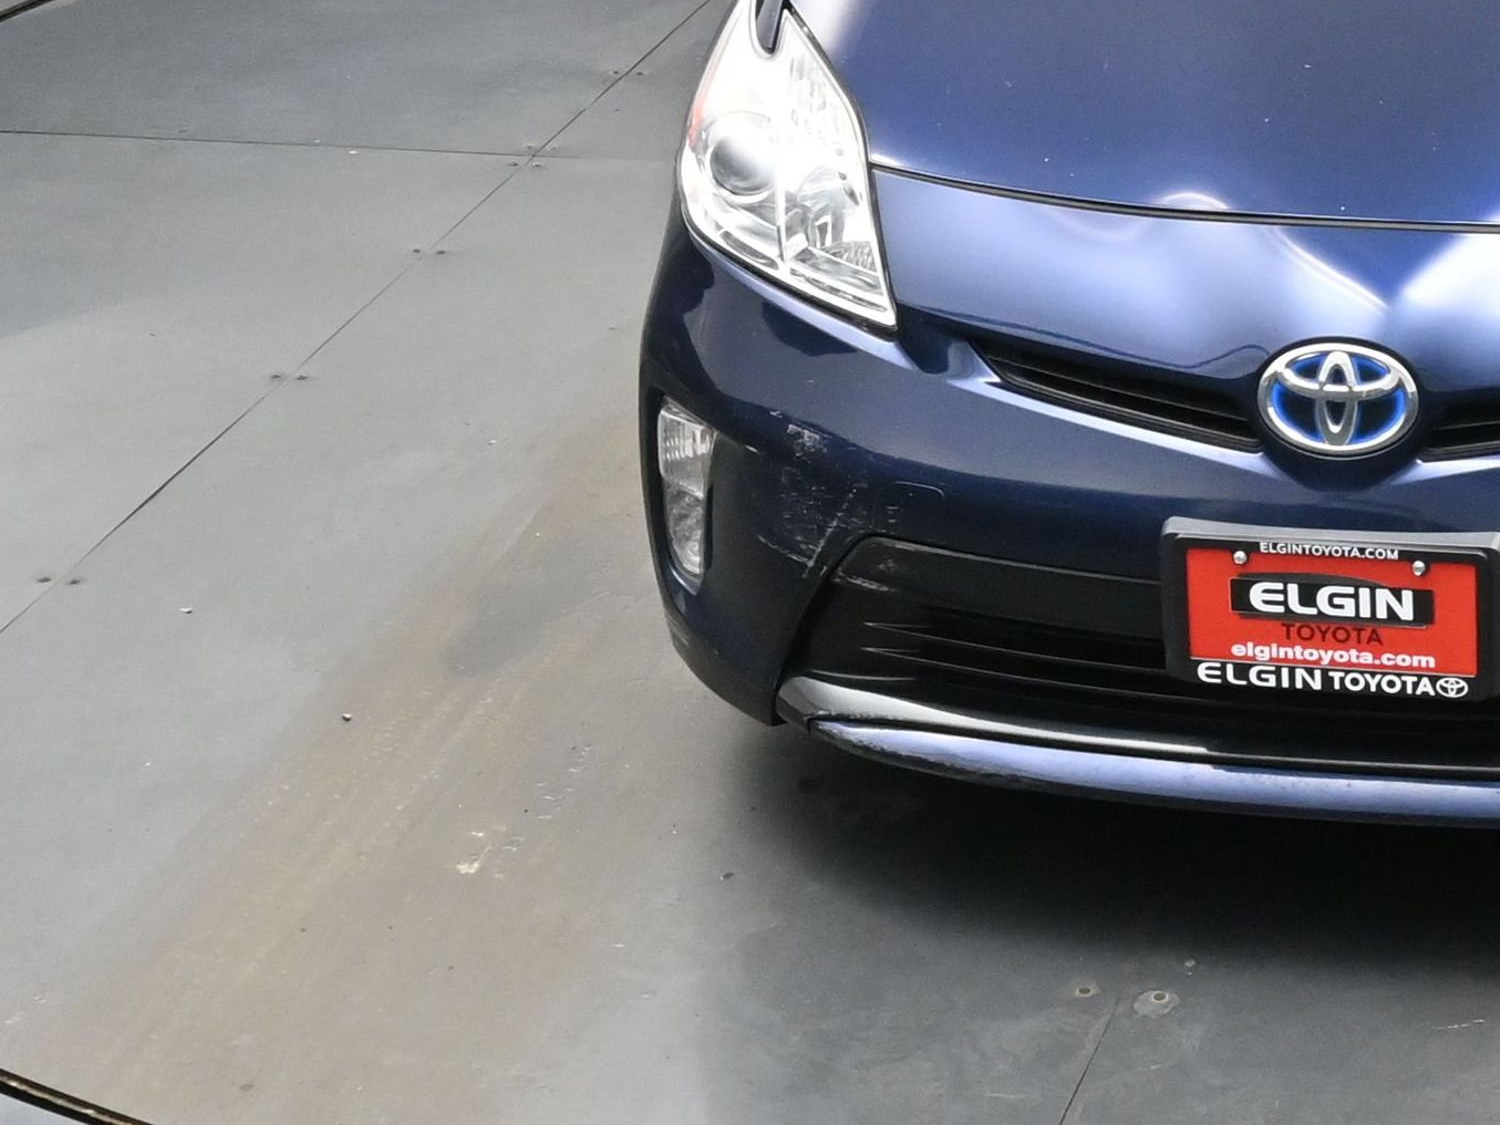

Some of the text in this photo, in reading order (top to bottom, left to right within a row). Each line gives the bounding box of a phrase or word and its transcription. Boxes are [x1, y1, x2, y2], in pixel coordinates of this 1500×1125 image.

[1259, 541, 1399, 561] ELGINTOYOTA.COM
[1249, 581, 1415, 622] ELGIN
[1281, 623, 1383, 646] TOYOTA
[1231, 641, 1436, 669] elgintoyota.com
